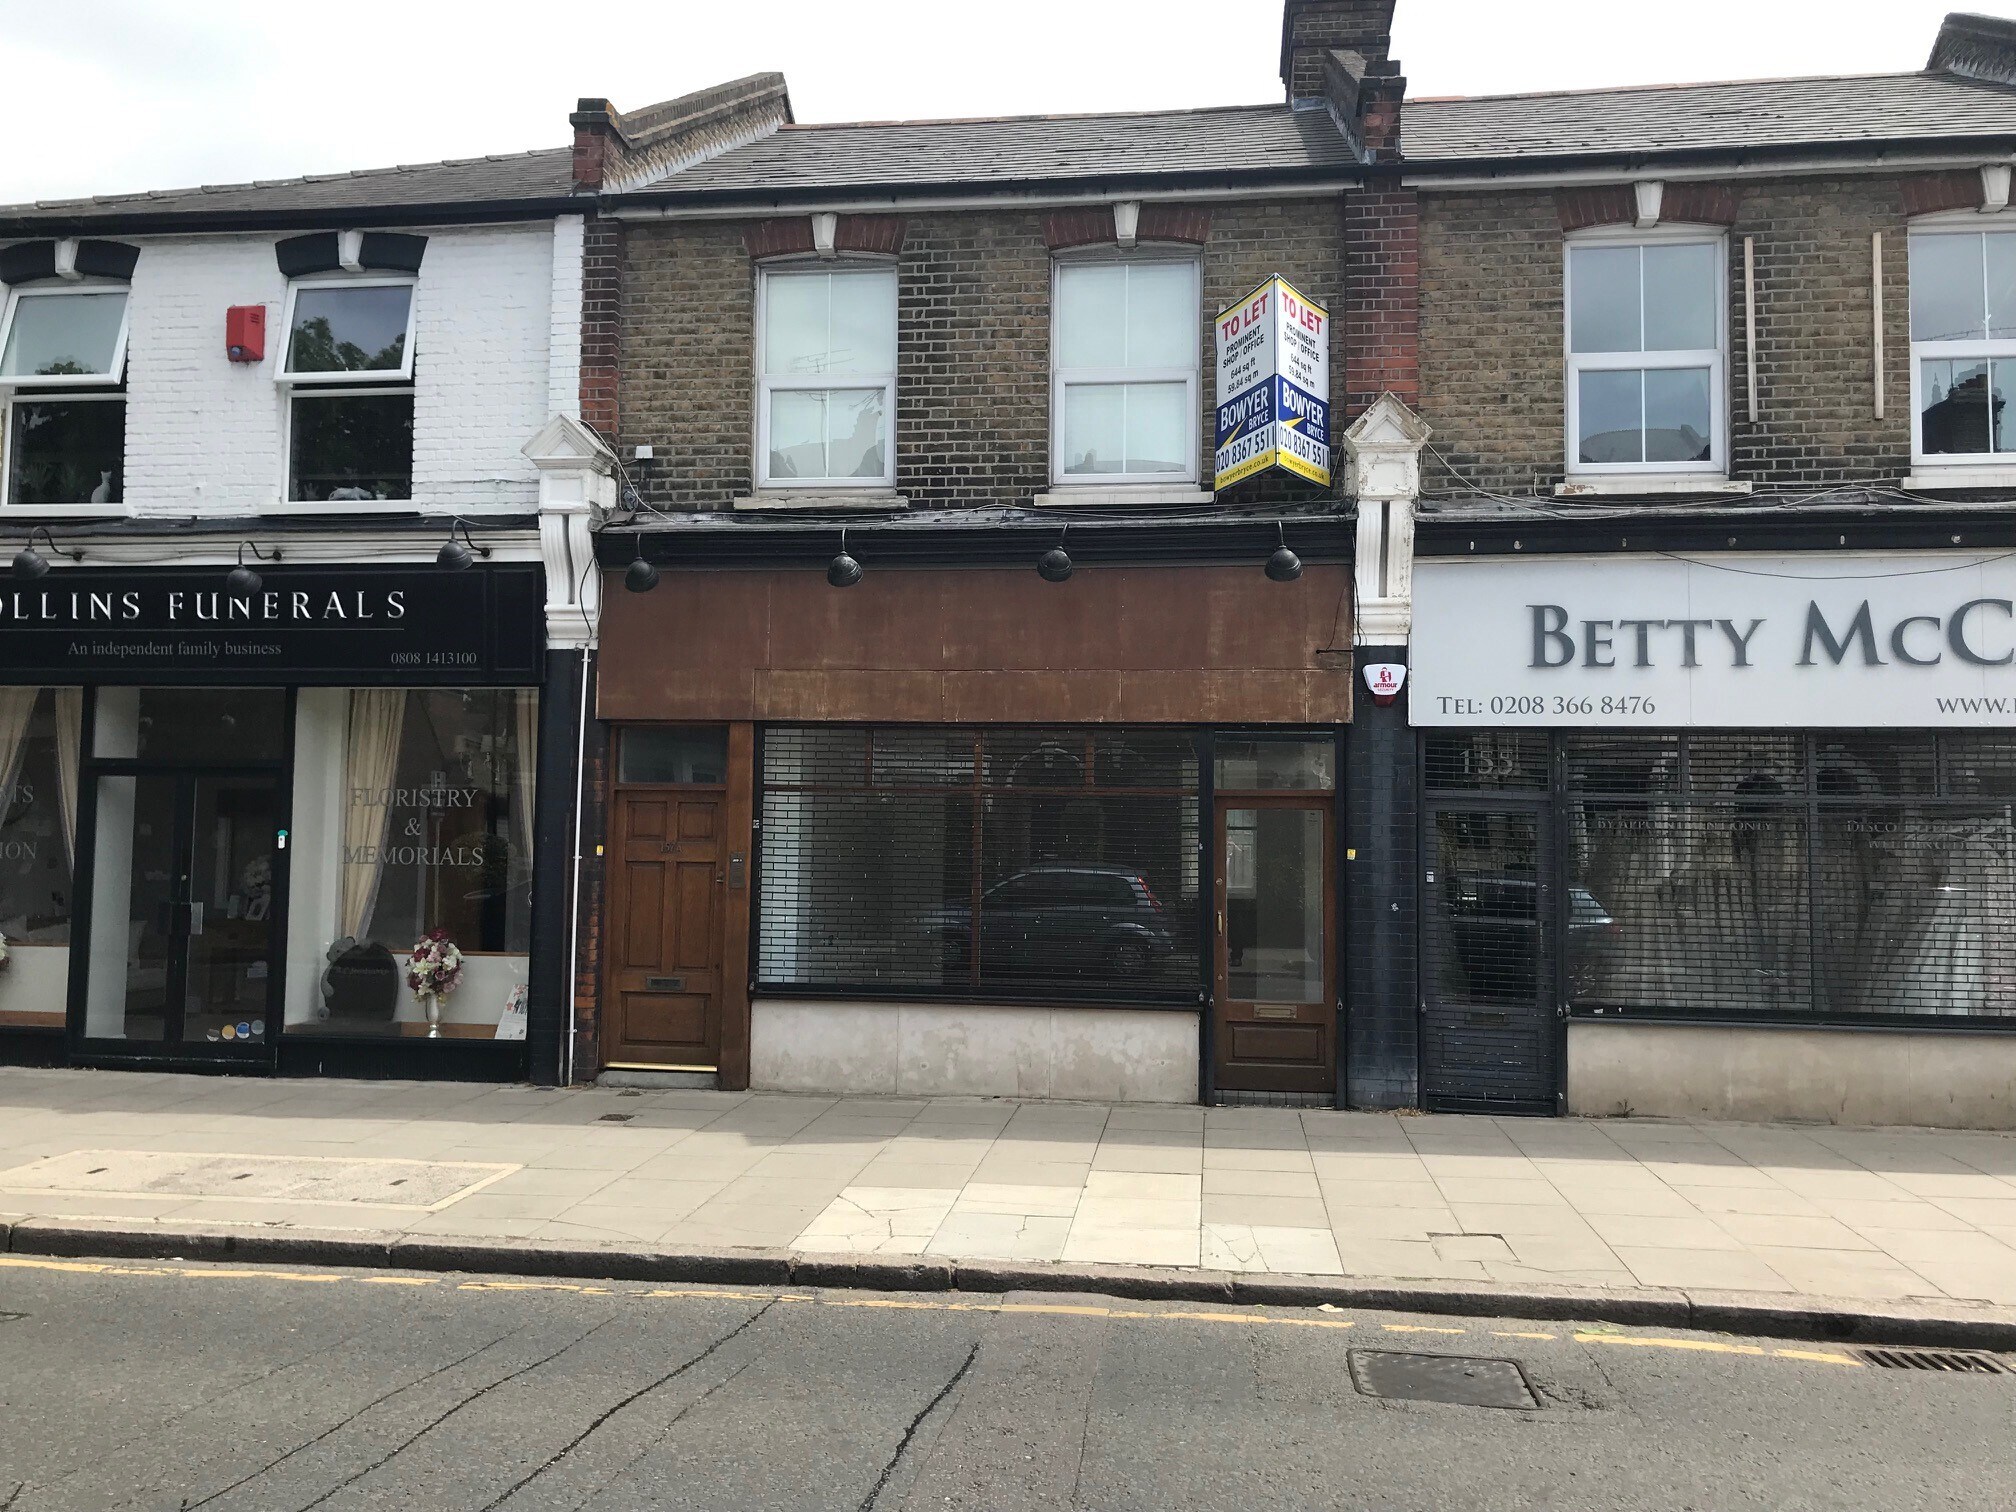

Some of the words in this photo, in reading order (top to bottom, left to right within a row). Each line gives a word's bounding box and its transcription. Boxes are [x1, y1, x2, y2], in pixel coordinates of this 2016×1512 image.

[1222, 316, 1240, 341] TO
[1244, 293, 1268, 328] LET
[1282, 291, 1296, 318] TO
[1300, 305, 1322, 335] LET
[1226, 325, 1261, 355] PROMINENT
[1284, 332, 1297, 347] SHOP
[1301, 344, 1320, 362] OFFICE
[1286, 322, 1316, 349] PROMINENT
[1223, 351, 1239, 368] SHOP
[1243, 334, 1264, 355] OFFICE
[1290, 353, 1299, 366] 644
[1230, 365, 1241, 379] 644
[1243, 362, 1250, 372] sq
[1250, 357, 1256, 366] ft
[1244, 376, 1251, 385] sq
[1220, 386, 1269, 432] BOWYER
[1282, 381, 1324, 427] BOWYER
[1248, 409, 1269, 430] BRYCE
[1306, 422, 1324, 441] BRYCE
[1216, 449, 1230, 473] 020
[1231, 437, 1252, 464] 8367
[1255, 425, 1275, 453] 5511
[1280, 426, 1292, 450] 020
[1293, 434, 1310, 460] 8367
[1312, 444, 1330, 470] 5511
[1220, 455, 1269, 483] bowyerbryce.co.uk
[0, 591, 141, 620] LLINS
[168, 590, 406, 620] FUNERALS
[1525, 604, 1767, 667] BETTY
[1795, 598, 2016, 665] McC
[68, 641, 88, 656] An
[92, 641, 174, 658] independent
[178, 641, 219, 659] family
[225, 641, 282, 656] business
[391, 652, 421, 664] 0808
[426, 651, 477, 664] 1413100
[1436, 696, 1483, 714] TEL:
[1490, 696, 1545, 715] 0208
[1552, 695, 1593, 715] 366
[1600, 696, 1656, 715] 8476
[1460, 749, 1512, 774] 155
[351, 787, 479, 808] FLORISTRY
[404, 817, 422, 836] &
[342, 845, 485, 866] MEMORIALS
